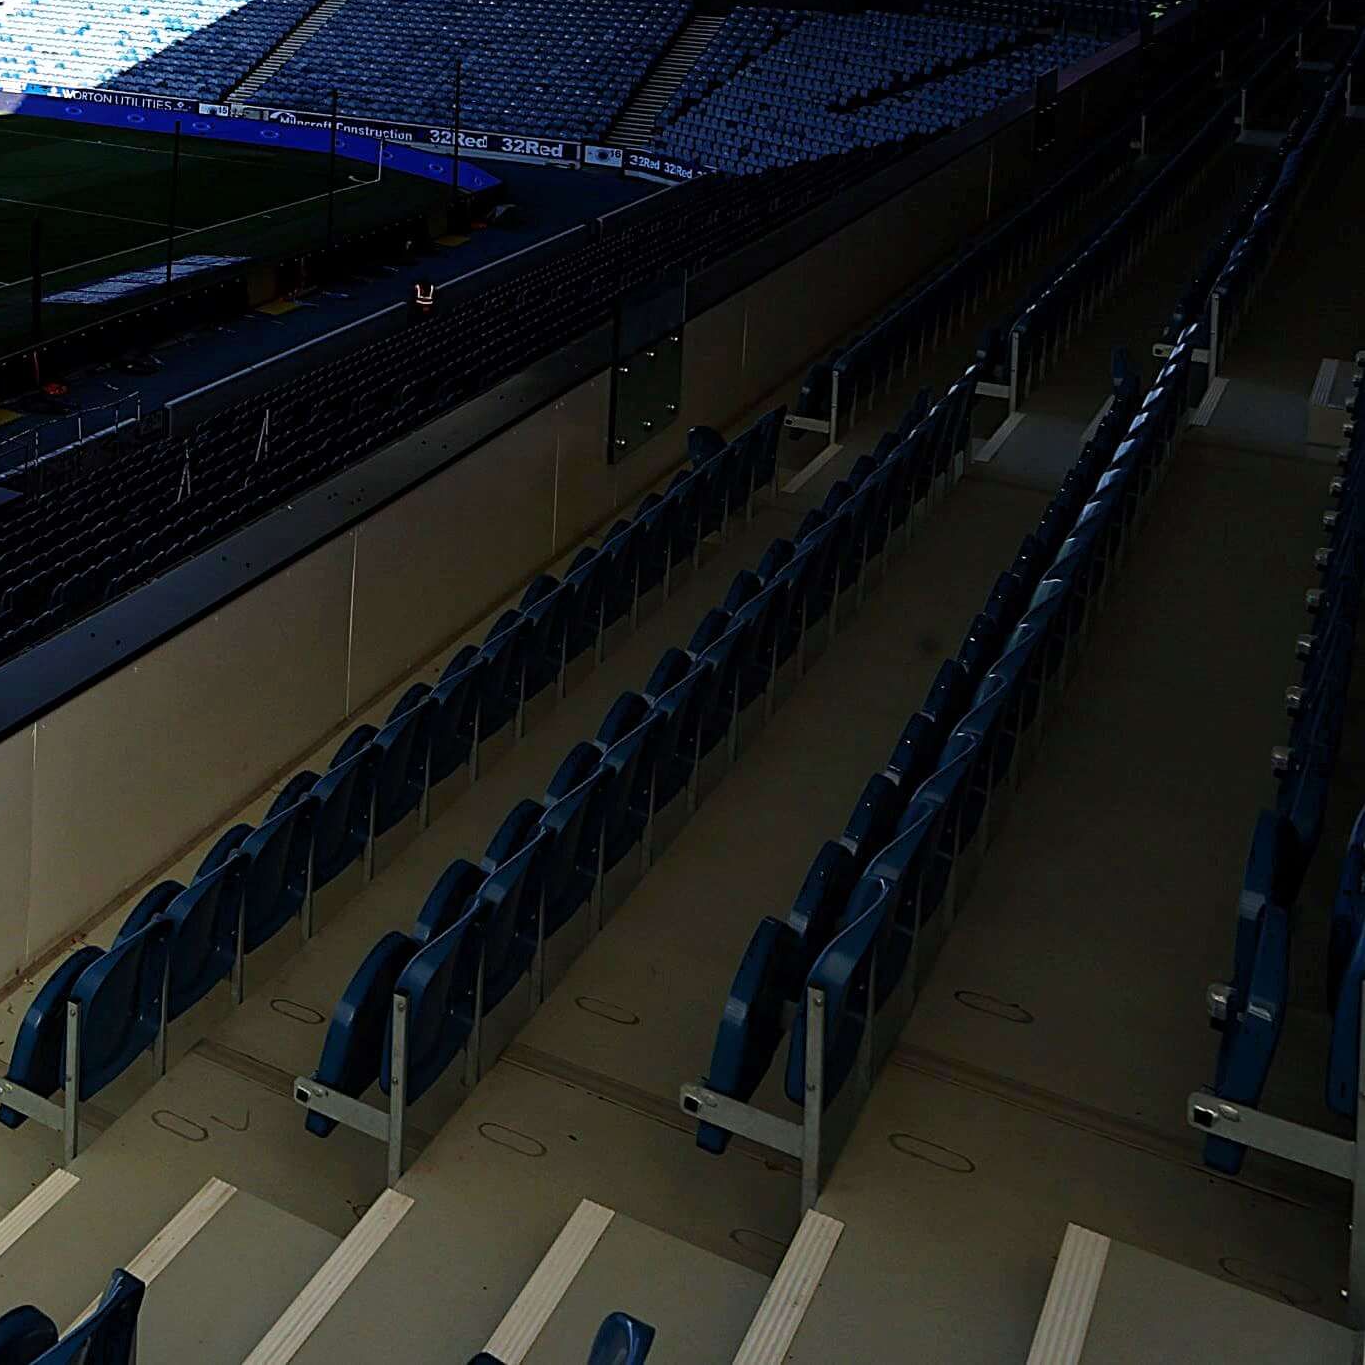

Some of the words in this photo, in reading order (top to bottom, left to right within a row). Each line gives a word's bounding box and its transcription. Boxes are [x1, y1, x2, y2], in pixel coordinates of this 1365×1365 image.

[429, 130, 488, 149] 32Red
[501, 137, 564, 158] 32Red
[629, 154, 661, 172] 32Red
[663, 162, 693, 180] 32Red
